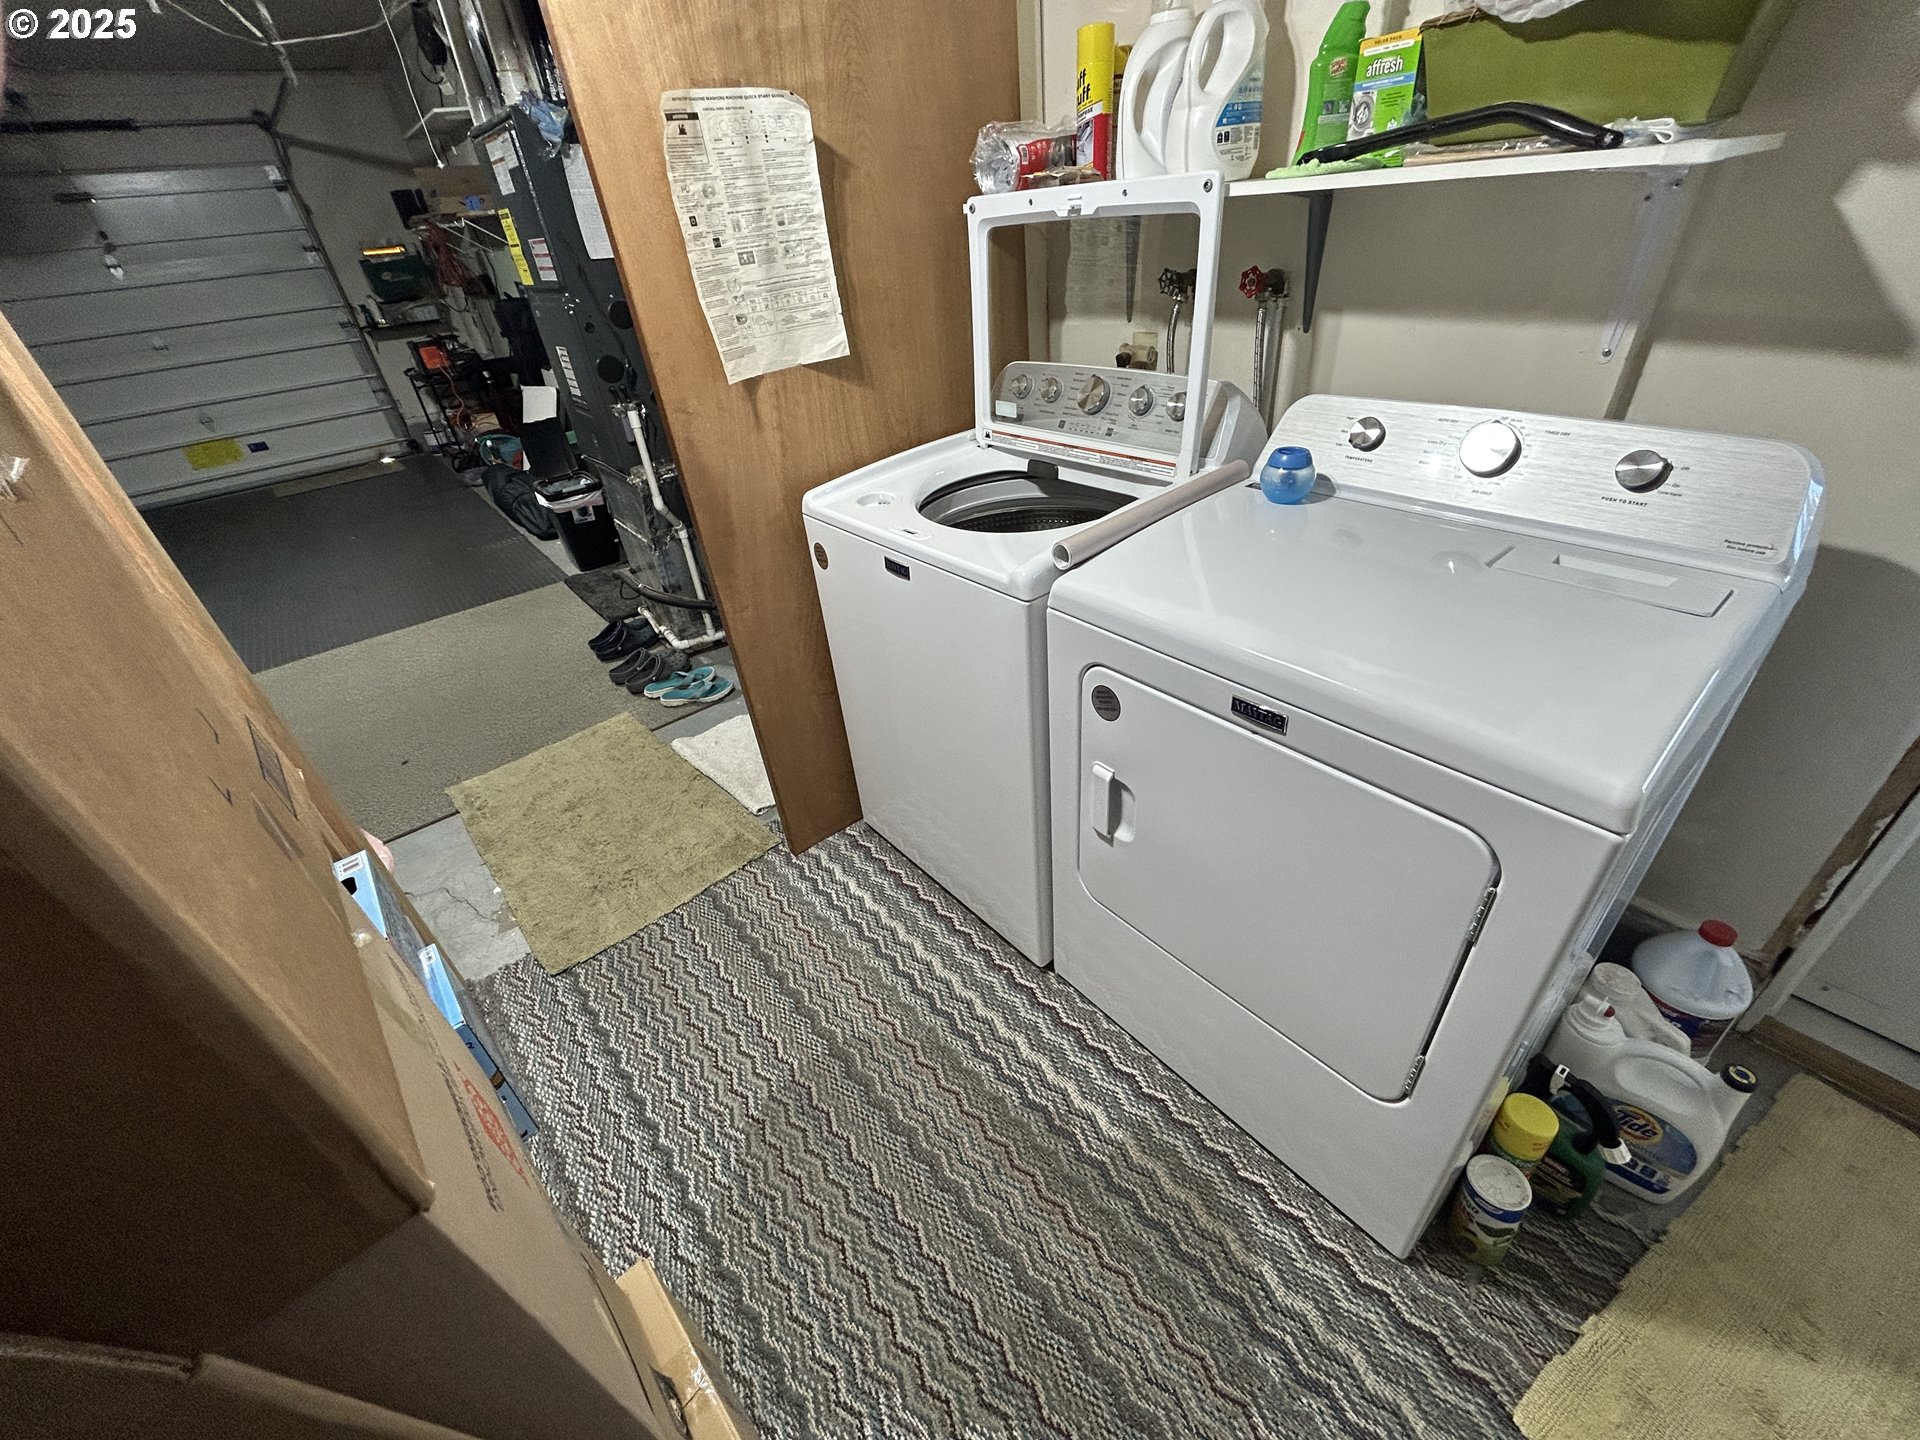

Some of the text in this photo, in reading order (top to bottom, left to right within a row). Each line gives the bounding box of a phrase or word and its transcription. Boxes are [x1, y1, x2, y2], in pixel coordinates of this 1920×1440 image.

[1366, 55, 1404, 78] affresh
[1628, 499, 1648, 508] START
[1233, 699, 1283, 728] MAYTAG
[1616, 1109, 1659, 1138] Tide
